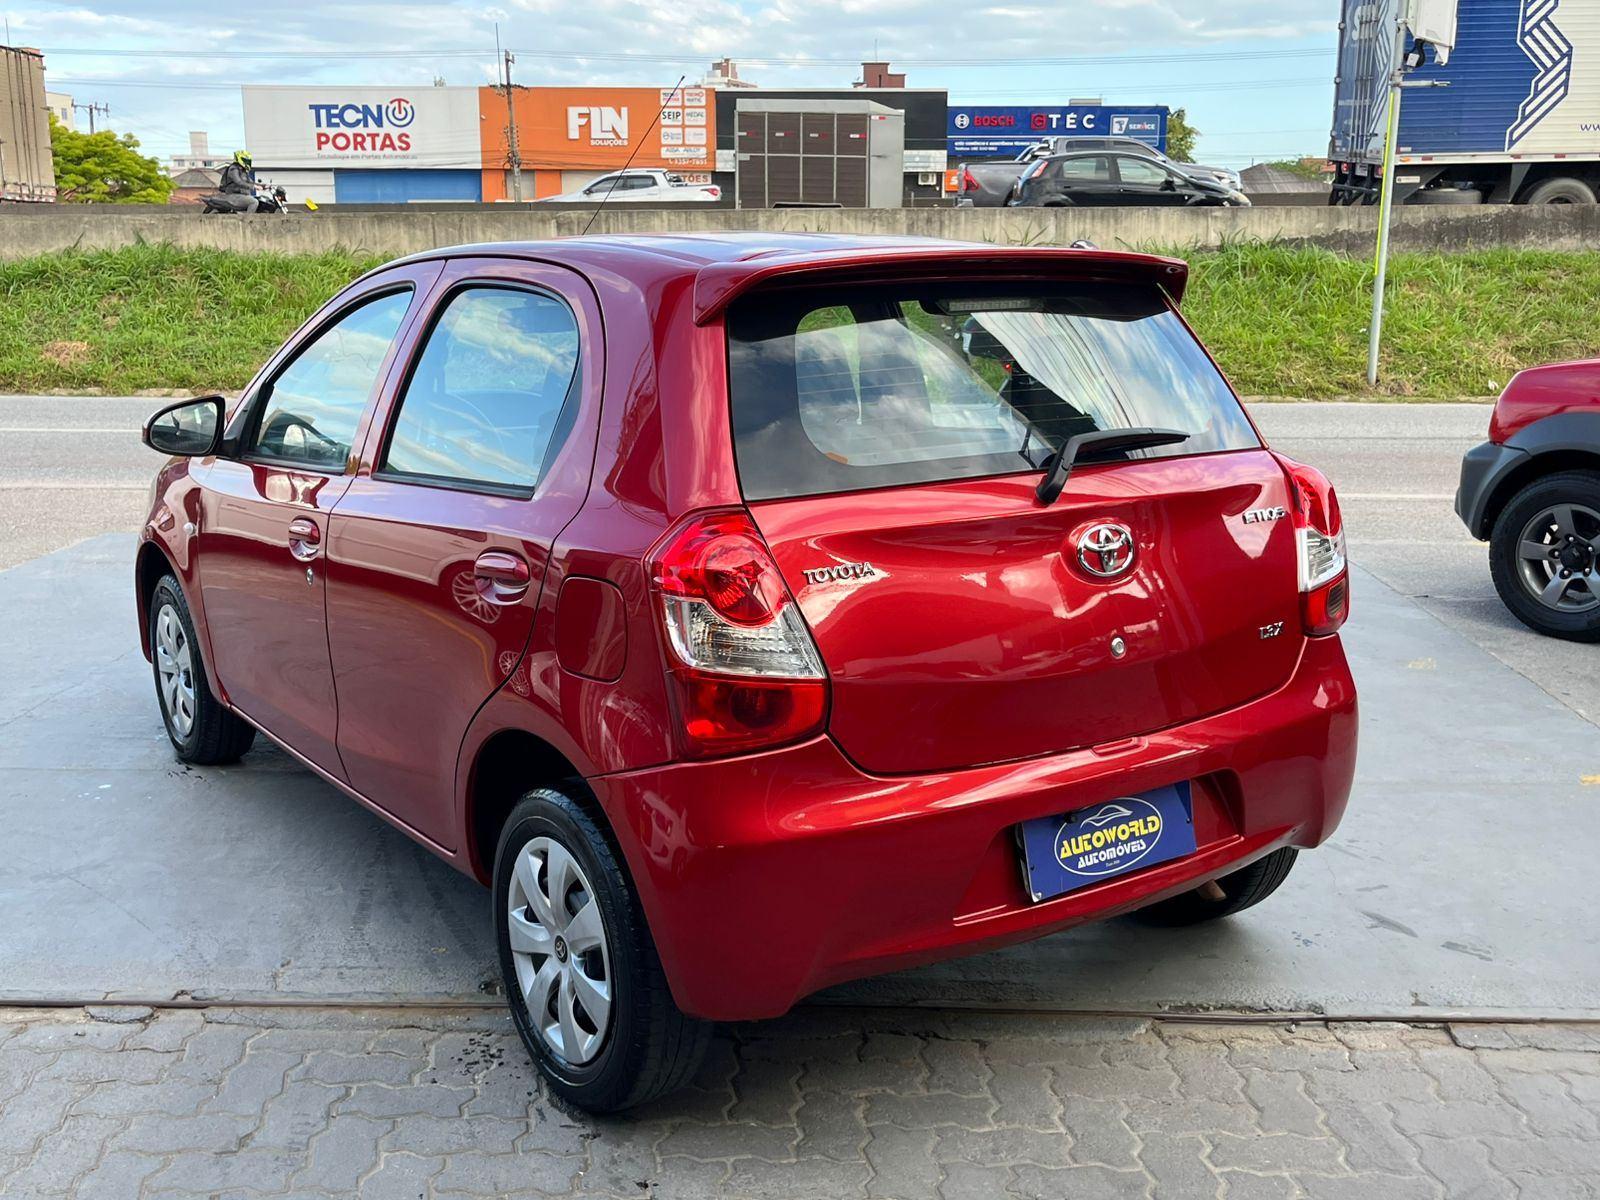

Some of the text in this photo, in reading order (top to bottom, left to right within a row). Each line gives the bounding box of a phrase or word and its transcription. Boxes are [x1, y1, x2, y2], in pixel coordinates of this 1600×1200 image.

[662, 111, 681, 120] SEIP
[973, 115, 1015, 127] BOSCH
[316, 132, 412, 151] PORTAS
[1242, 506, 1285, 525] ETIOS
[801, 562, 876, 585] TOYOTA
[1060, 815, 1160, 859] AUTOWORLD
[1077, 839, 1147, 869] AUTOMÓVEIS
